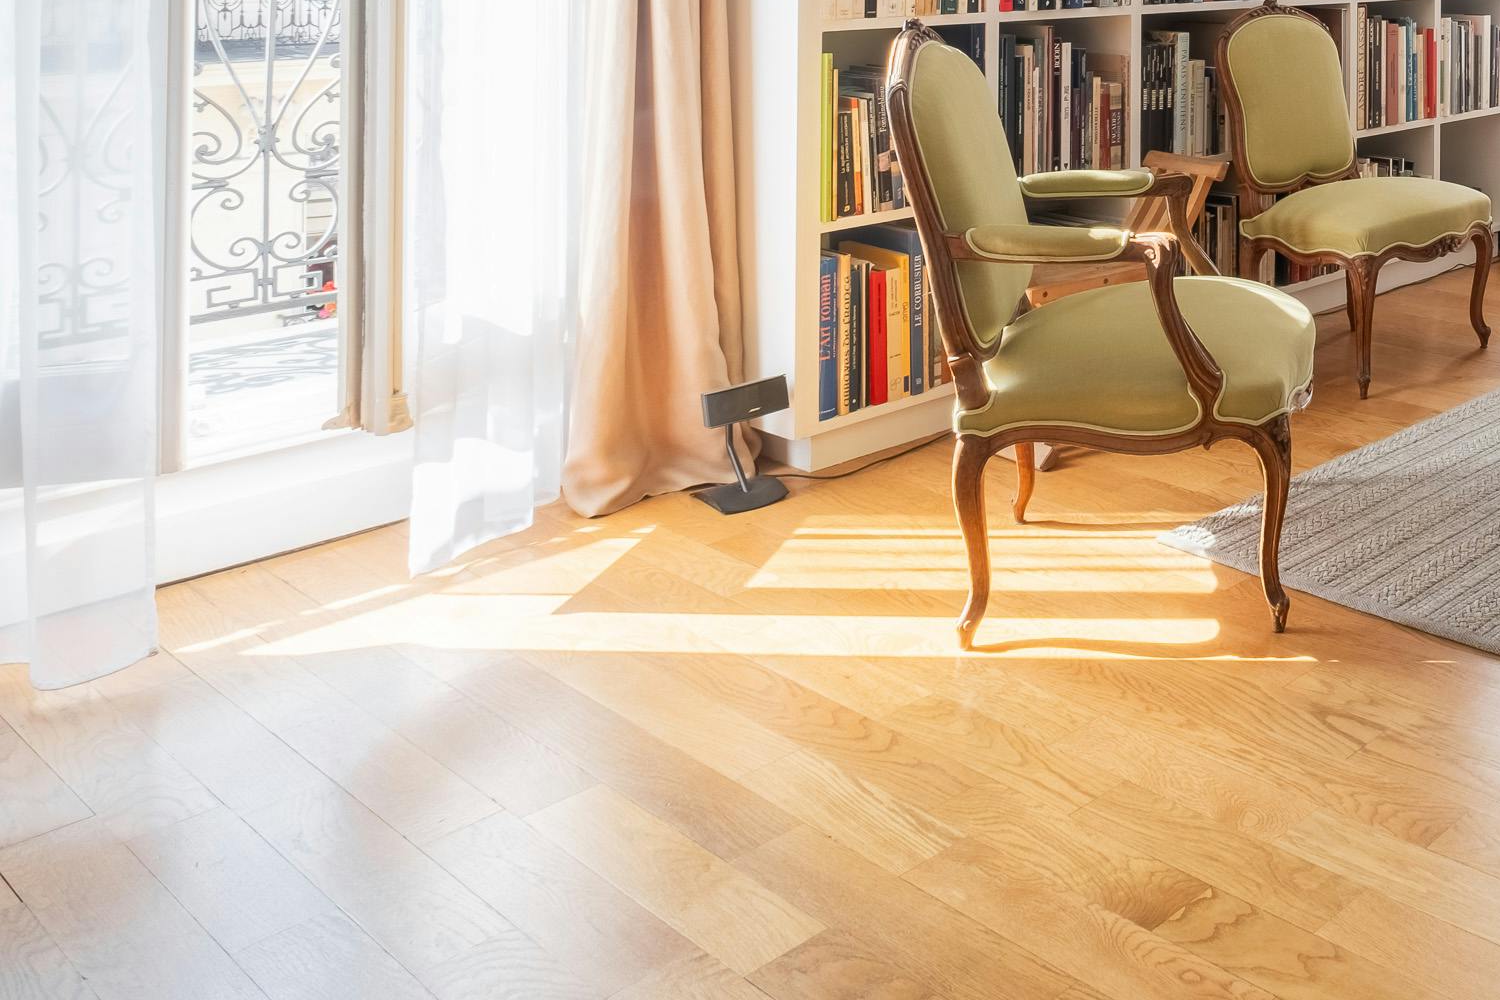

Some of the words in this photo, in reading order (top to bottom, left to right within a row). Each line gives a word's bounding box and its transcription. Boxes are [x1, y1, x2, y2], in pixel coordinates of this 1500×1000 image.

[878, 86, 887, 132] Fontainebleau
[821, 273, 831, 321] roman
[915, 313, 922, 327] LE
[820, 327, 831, 361] L'Art
